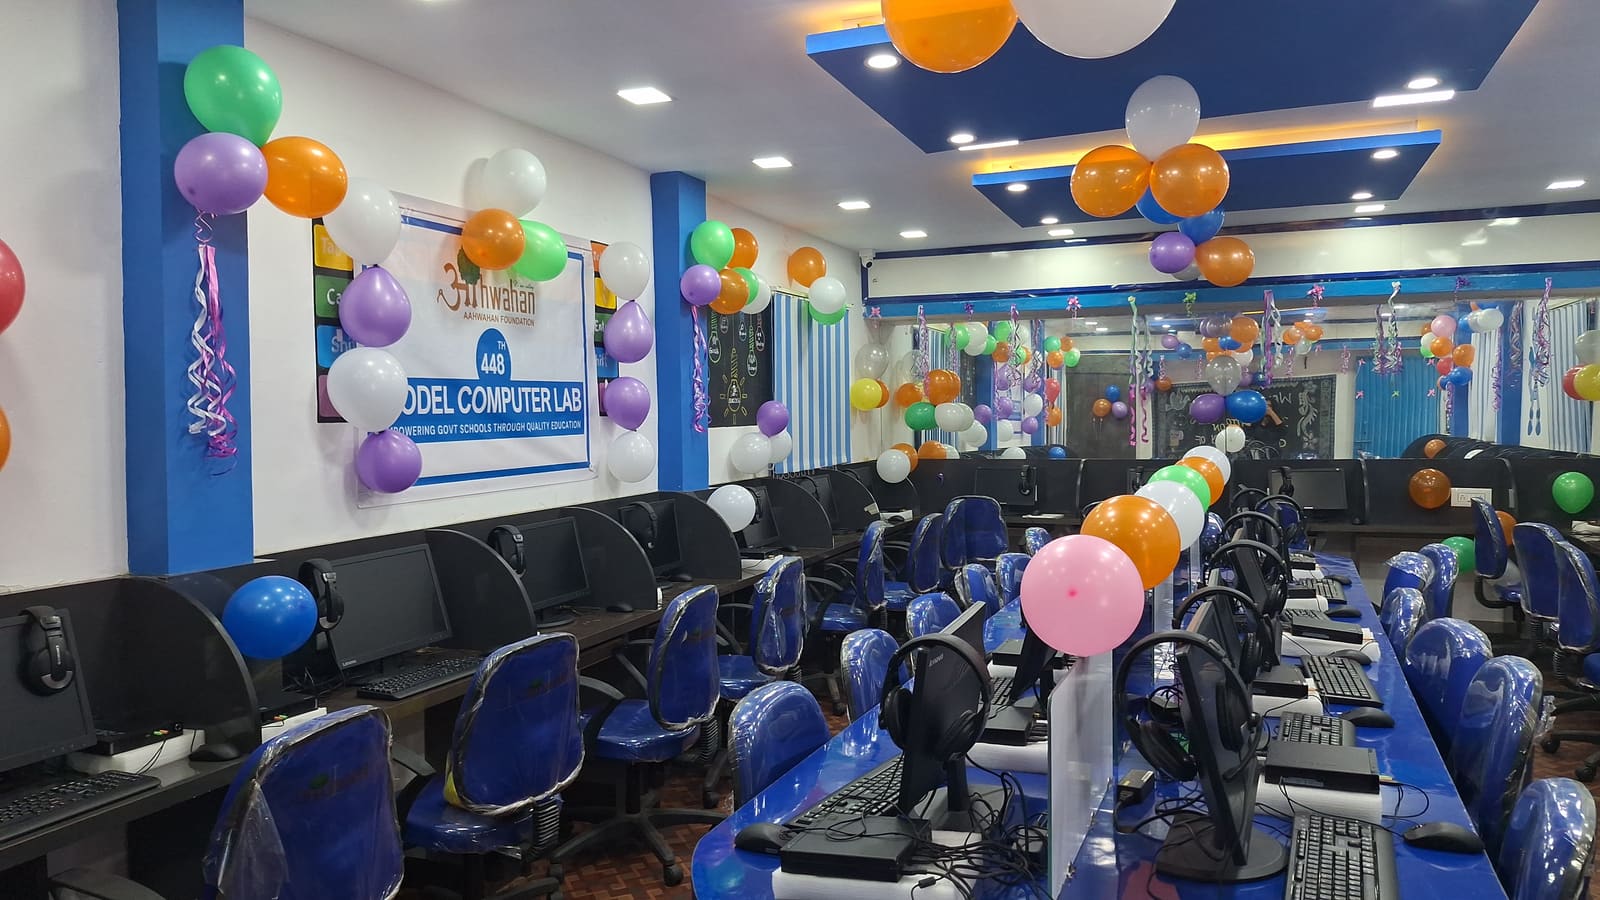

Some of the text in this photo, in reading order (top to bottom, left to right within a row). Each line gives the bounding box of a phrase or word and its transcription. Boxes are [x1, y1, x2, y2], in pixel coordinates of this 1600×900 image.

[463, 311, 535, 327] AAHWAHAN FOUNDATION
[497, 340, 506, 351] TH
[481, 353, 505, 375] 448
[402, 384, 582, 415] ODEL COMPUTER LAB
[438, 424, 459, 435] GOVT
[459, 423, 492, 434] SCHOOLS
[493, 422, 526, 433] THROUGH
[526, 421, 550, 432] QUALITY
[551, 420, 581, 430] EDUCATION
